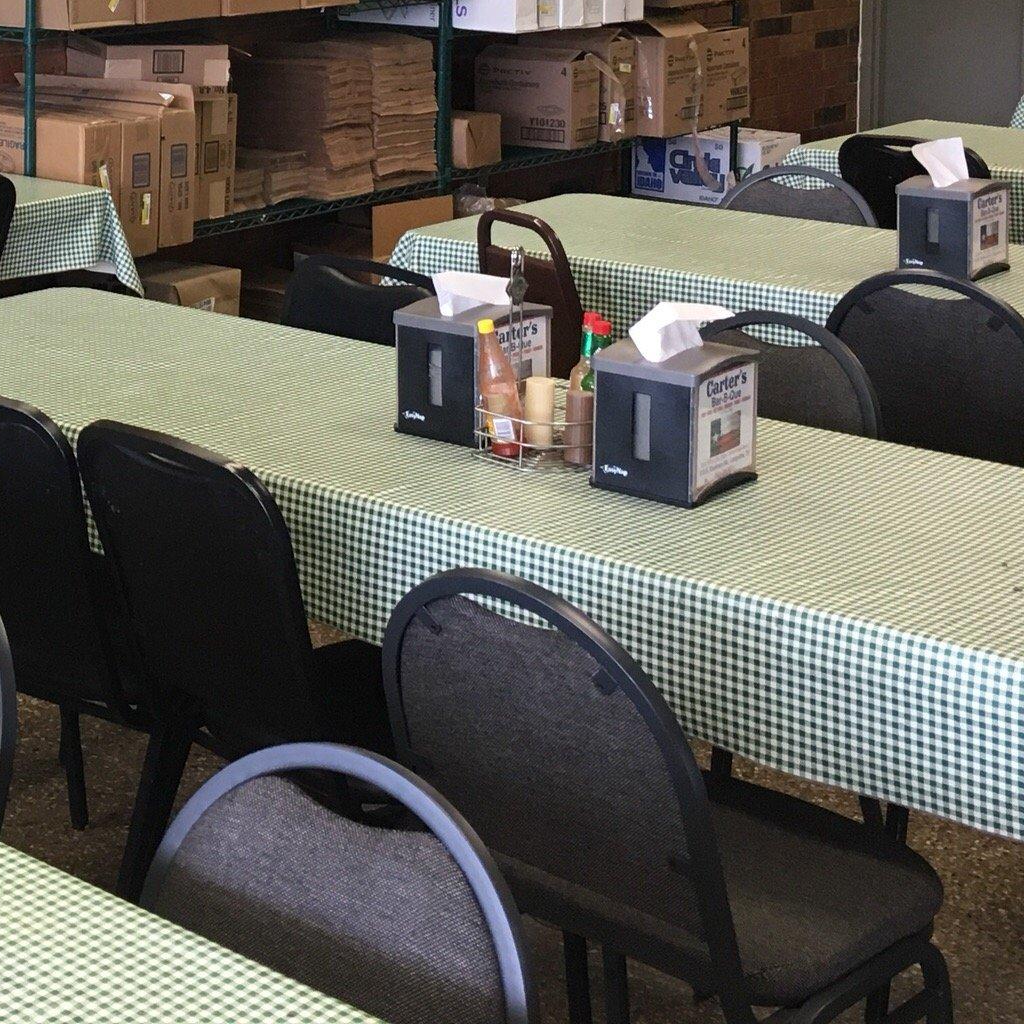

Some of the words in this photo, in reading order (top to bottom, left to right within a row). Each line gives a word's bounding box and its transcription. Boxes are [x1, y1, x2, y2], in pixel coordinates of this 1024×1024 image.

[561, 67, 567, 76] 4
[495, 321, 538, 344] arter's
[707, 369, 747, 397] Carter's
